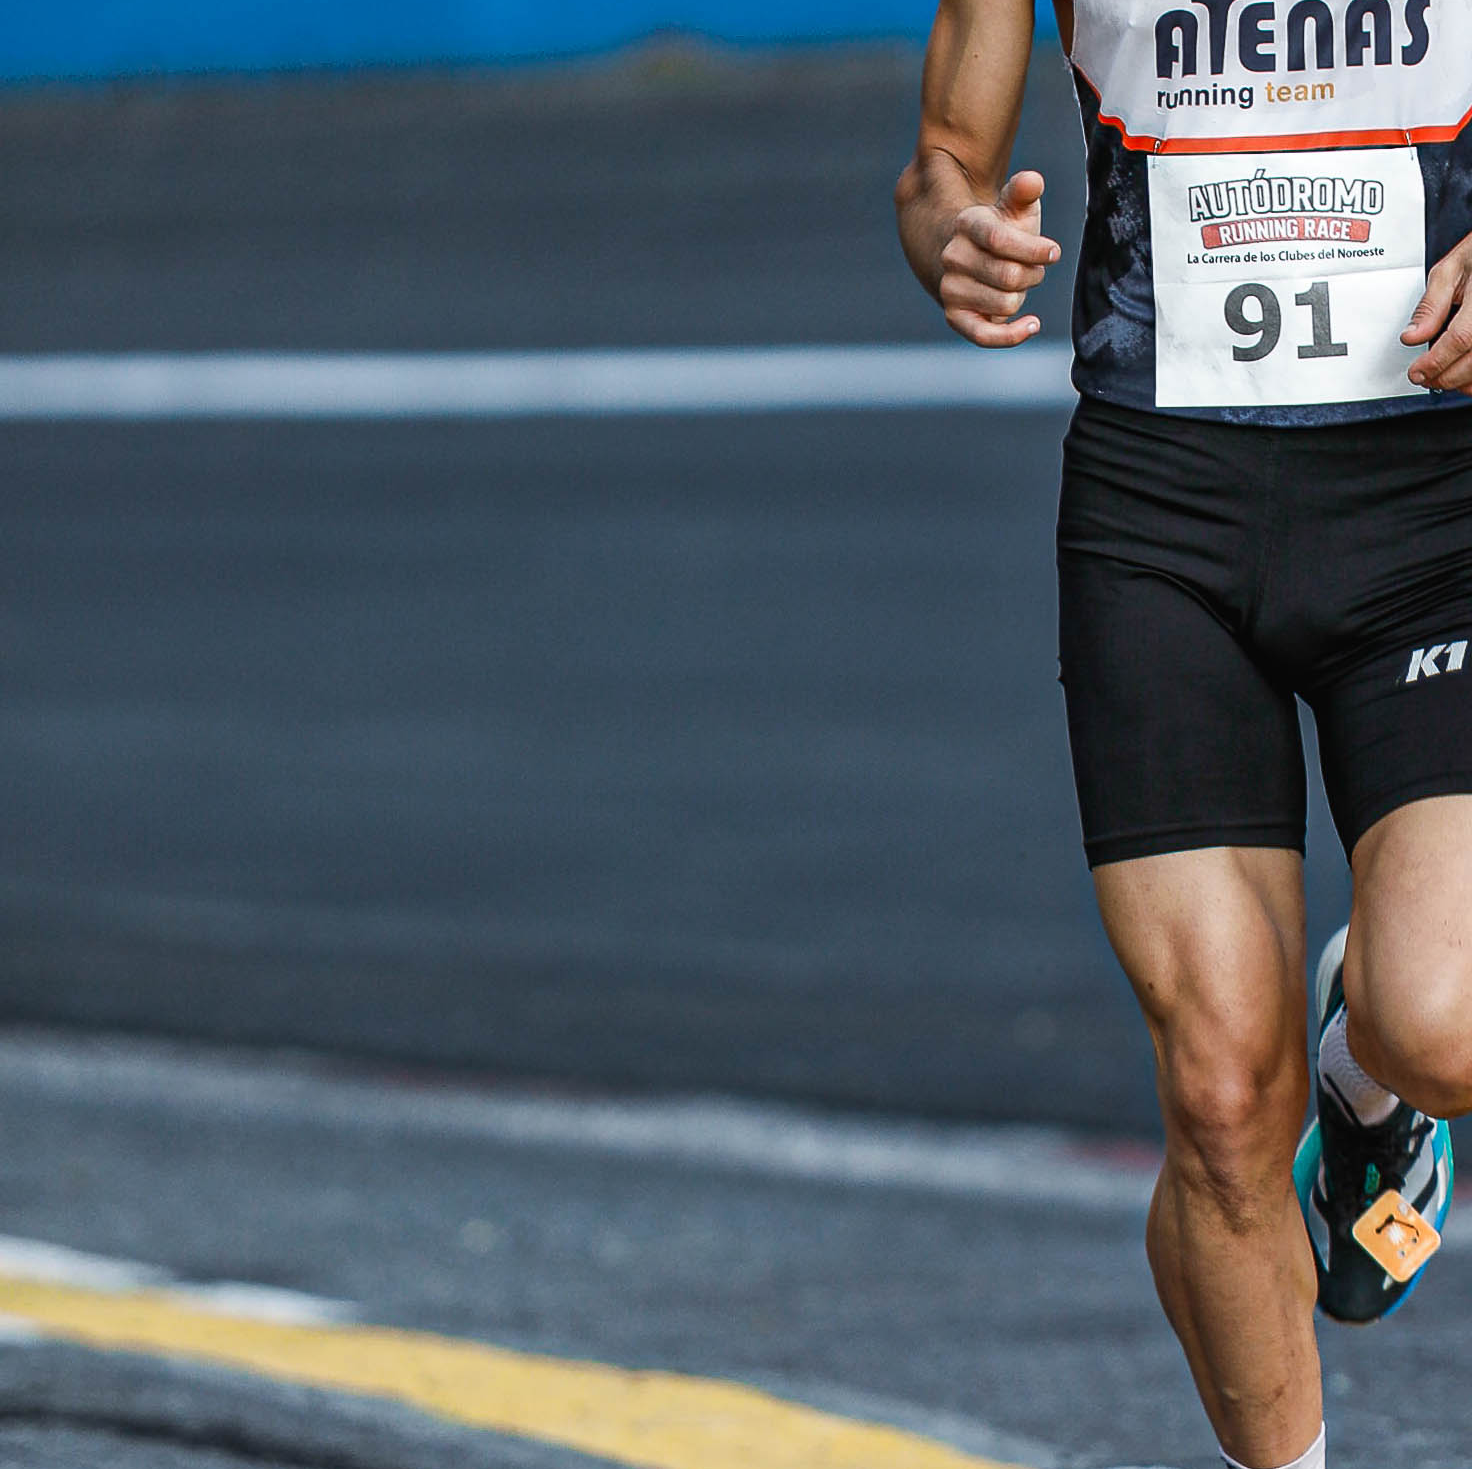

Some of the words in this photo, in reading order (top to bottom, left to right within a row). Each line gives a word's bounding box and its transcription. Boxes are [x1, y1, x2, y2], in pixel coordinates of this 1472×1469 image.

[1156, 82, 1254, 109] running
[1266, 81, 1335, 103] team
[1188, 168, 1384, 223] AUTÓDROMO
[1217, 218, 1299, 245] RUNNING
[1303, 219, 1353, 241] RACE
[1187, 252, 1199, 264] La
[1202, 253, 1241, 264] Carrera
[1243, 251, 1258, 262] de
[1260, 251, 1276, 262] los
[1278, 249, 1316, 261] Clubes
[1318, 248, 1335, 260] del
[1337, 246, 1385, 259] Noroeste
[1223, 281, 1349, 363] 91
[1405, 640, 1468, 683] K1
